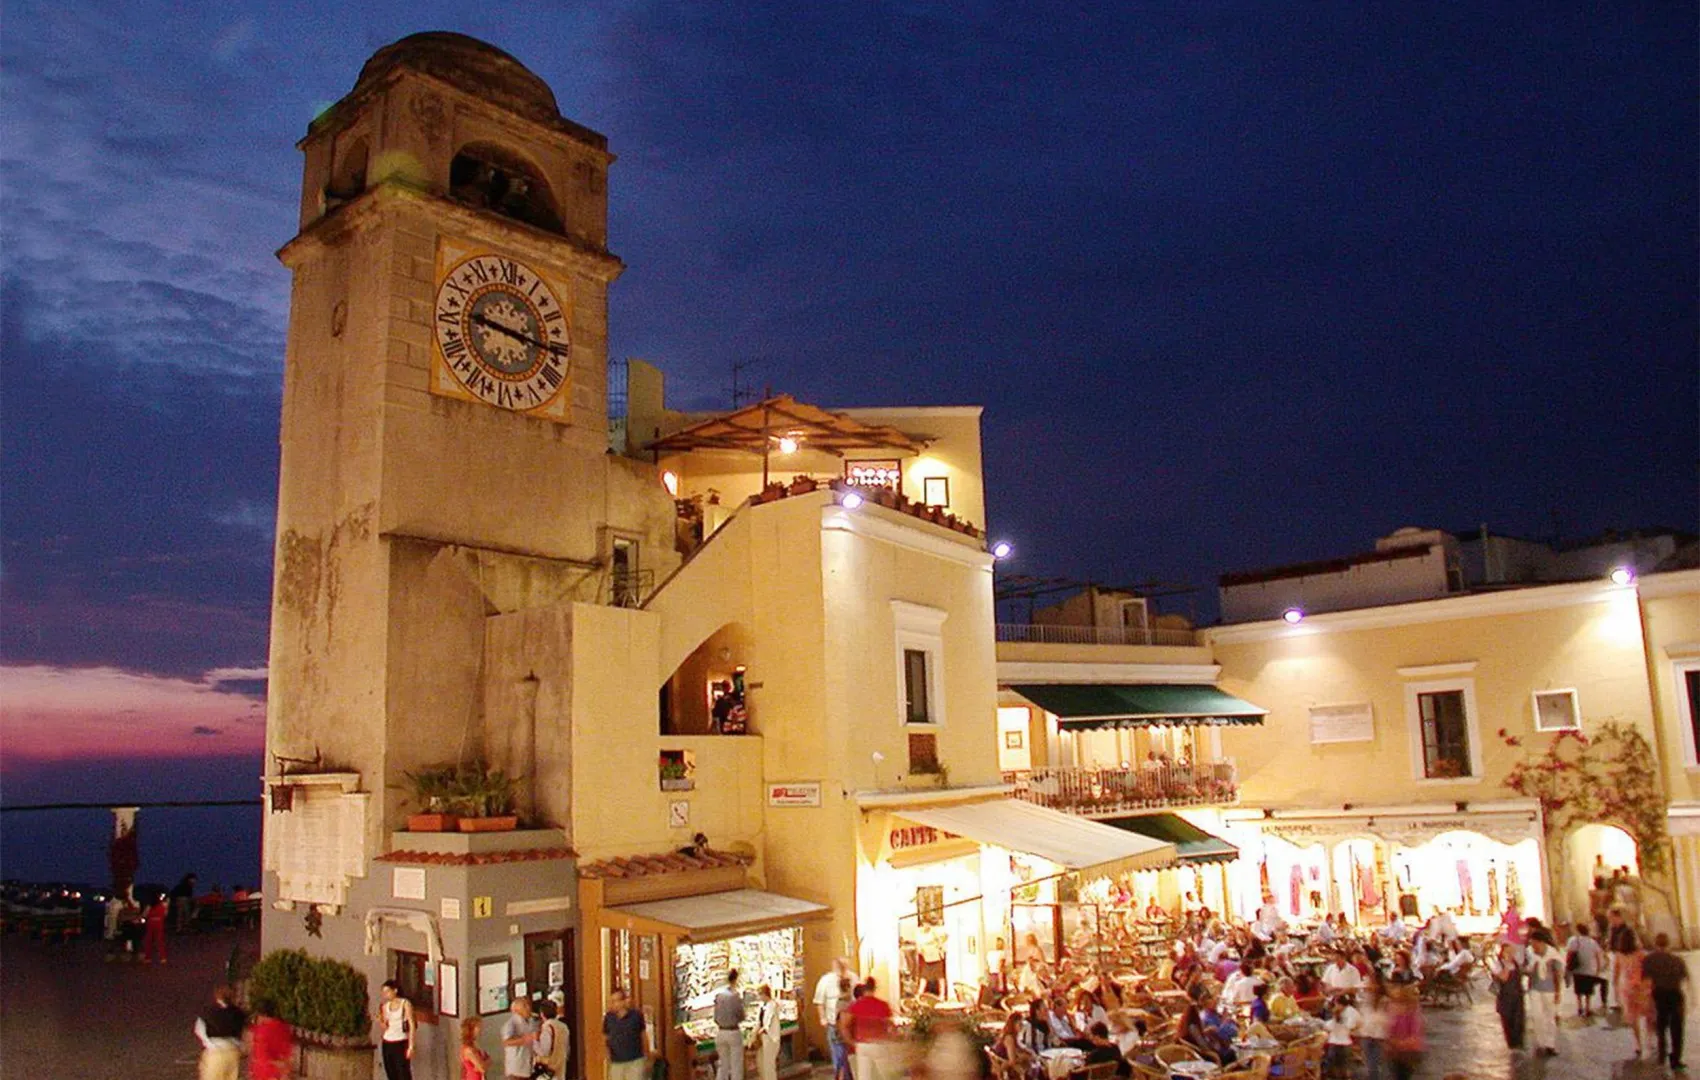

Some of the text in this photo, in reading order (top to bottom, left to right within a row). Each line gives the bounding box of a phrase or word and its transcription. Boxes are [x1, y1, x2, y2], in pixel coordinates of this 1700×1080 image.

[468, 260, 488, 283] XI
[500, 259, 518, 285] XII
[446, 276, 470, 299] X
[529, 280, 540, 296] I
[438, 306, 461, 326] IX
[543, 311, 562, 323] II
[498, 382, 514, 408] VI
[526, 384, 542, 403] V
